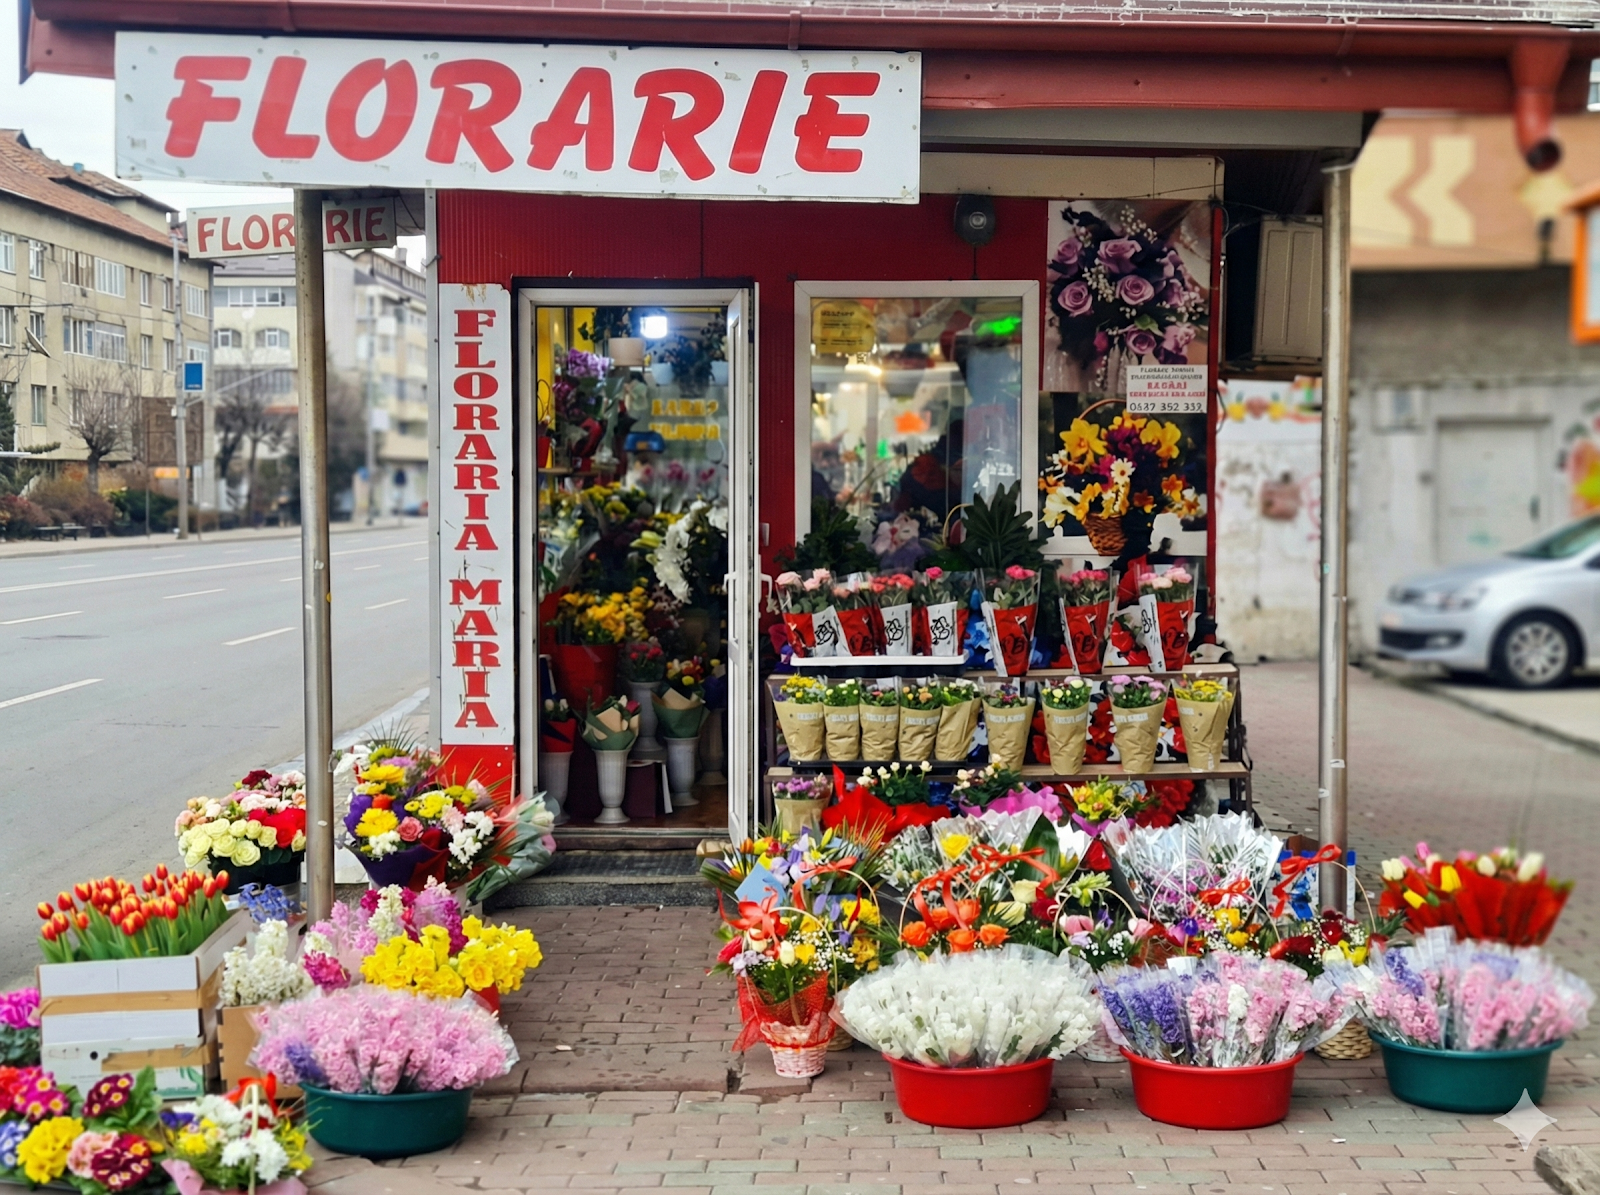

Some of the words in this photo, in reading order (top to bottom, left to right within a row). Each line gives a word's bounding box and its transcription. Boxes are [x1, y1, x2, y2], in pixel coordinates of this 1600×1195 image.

[165, 56, 881, 181] FLORARIE
[197, 206, 388, 253] FLORRIE
[453, 309, 500, 551] FLORARIA
[449, 579, 502, 728] MARIA
